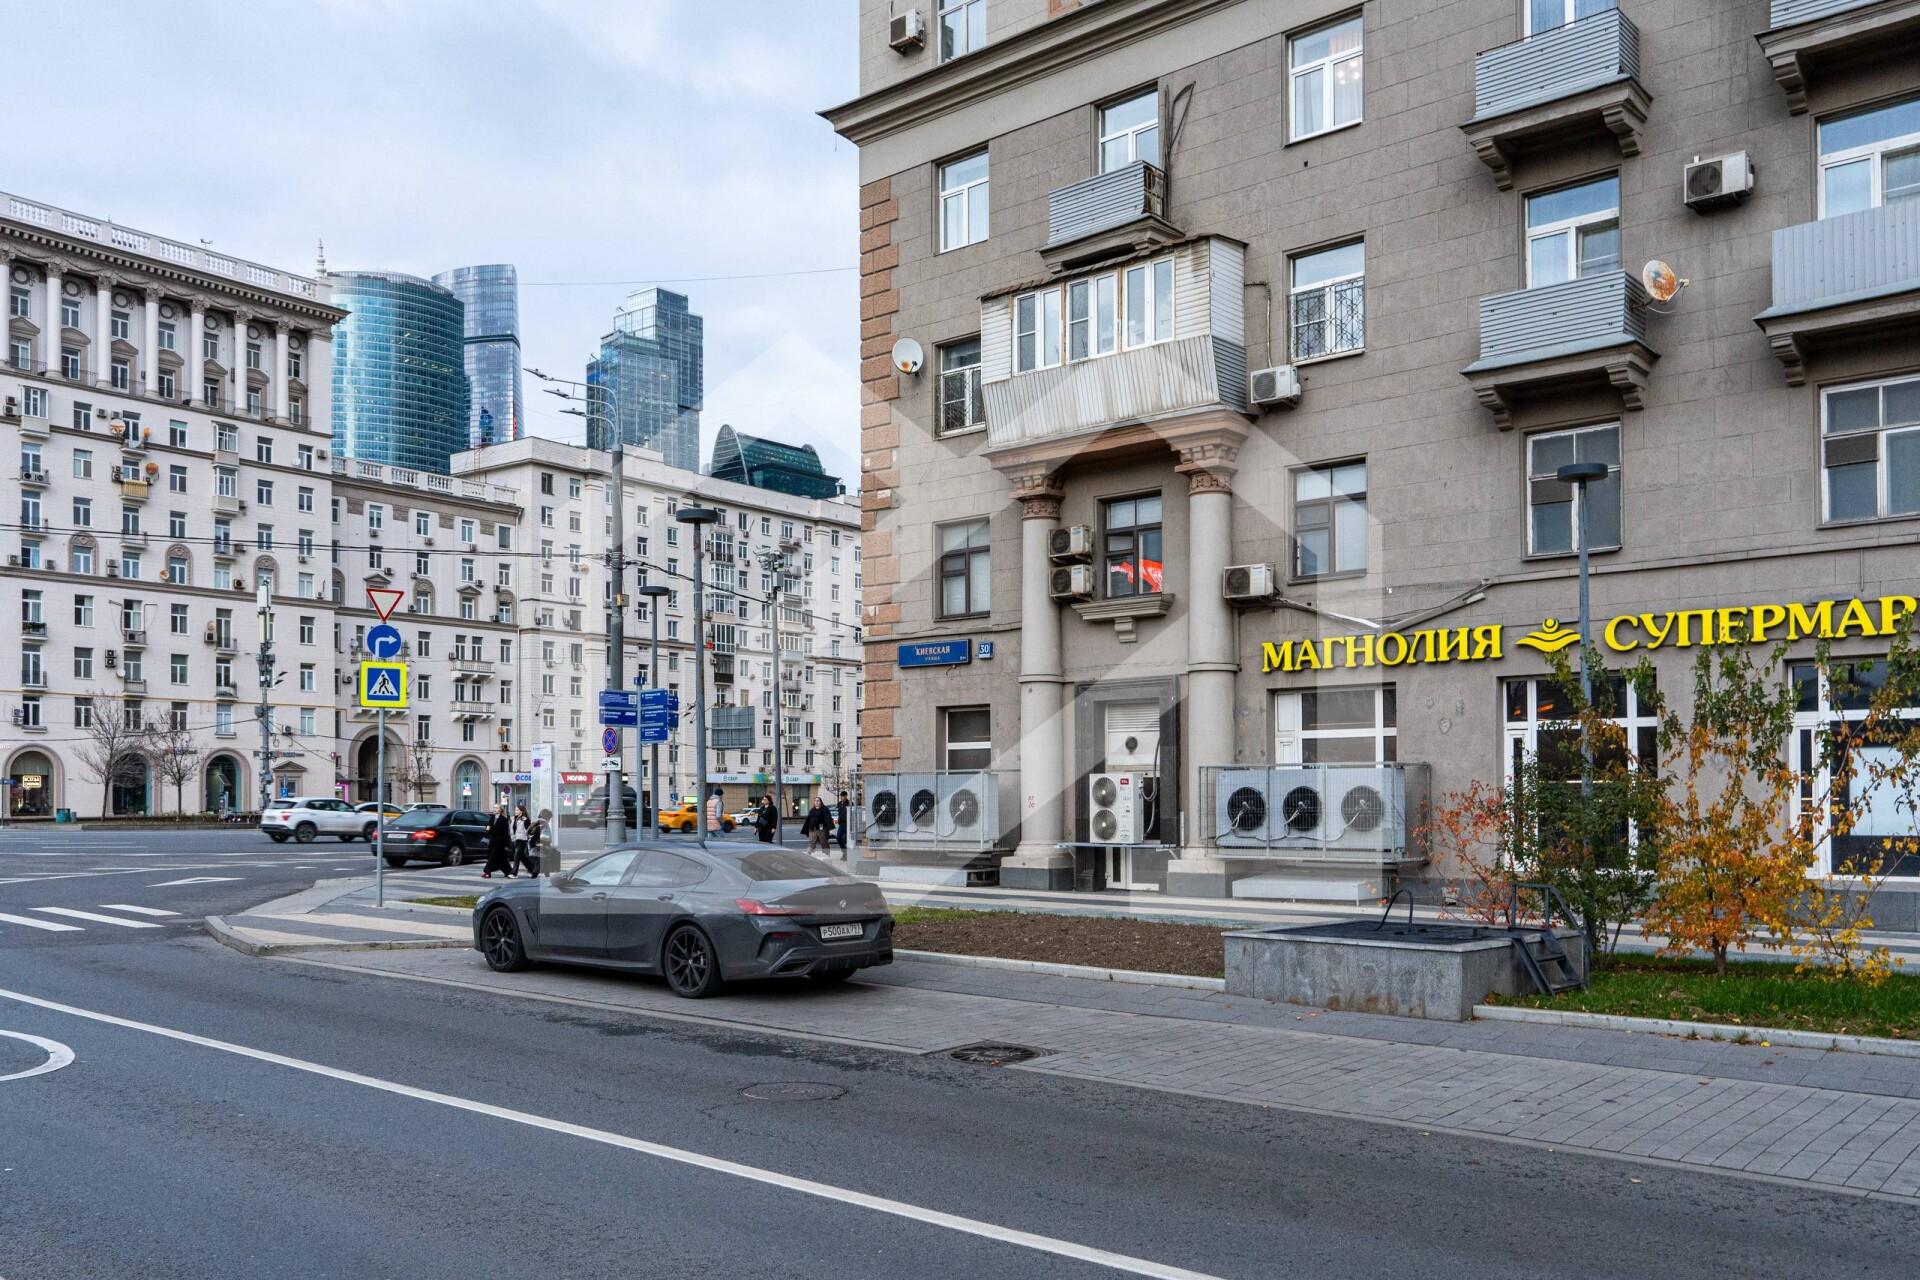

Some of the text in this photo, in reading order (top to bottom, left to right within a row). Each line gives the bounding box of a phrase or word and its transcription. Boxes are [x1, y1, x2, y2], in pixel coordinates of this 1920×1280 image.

[1604, 595, 1918, 652] СУПЕРМАР
[916, 645, 950, 656] КИЕВСКАЯ
[980, 644, 989, 654] 30
[1261, 624, 1503, 673] МАГНОЛИЯ
